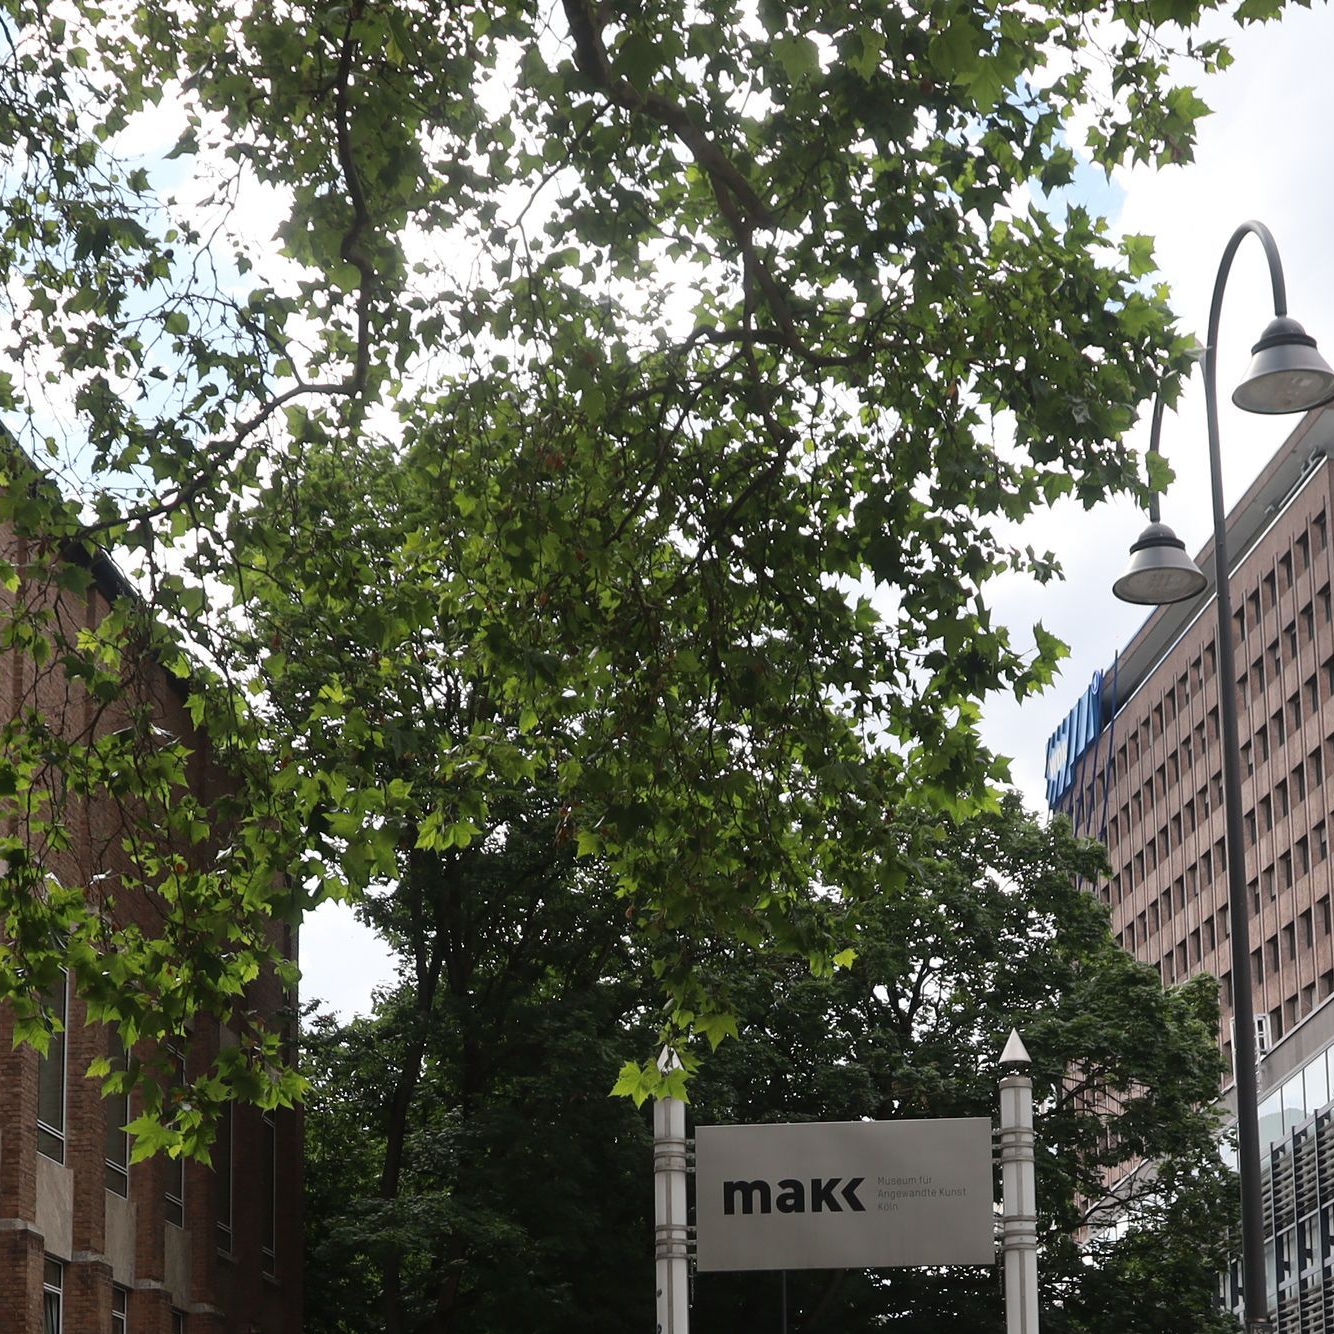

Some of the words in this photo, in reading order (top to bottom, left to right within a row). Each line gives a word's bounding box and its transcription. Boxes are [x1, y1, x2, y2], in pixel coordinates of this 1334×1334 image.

[877, 1176, 917, 1186] Museum
[919, 1176, 932, 1185] für
[878, 1187, 937, 1200] Angewandte
[939, 1187, 967, 1197] Kunst
[877, 1201, 898, 1211] Köln
